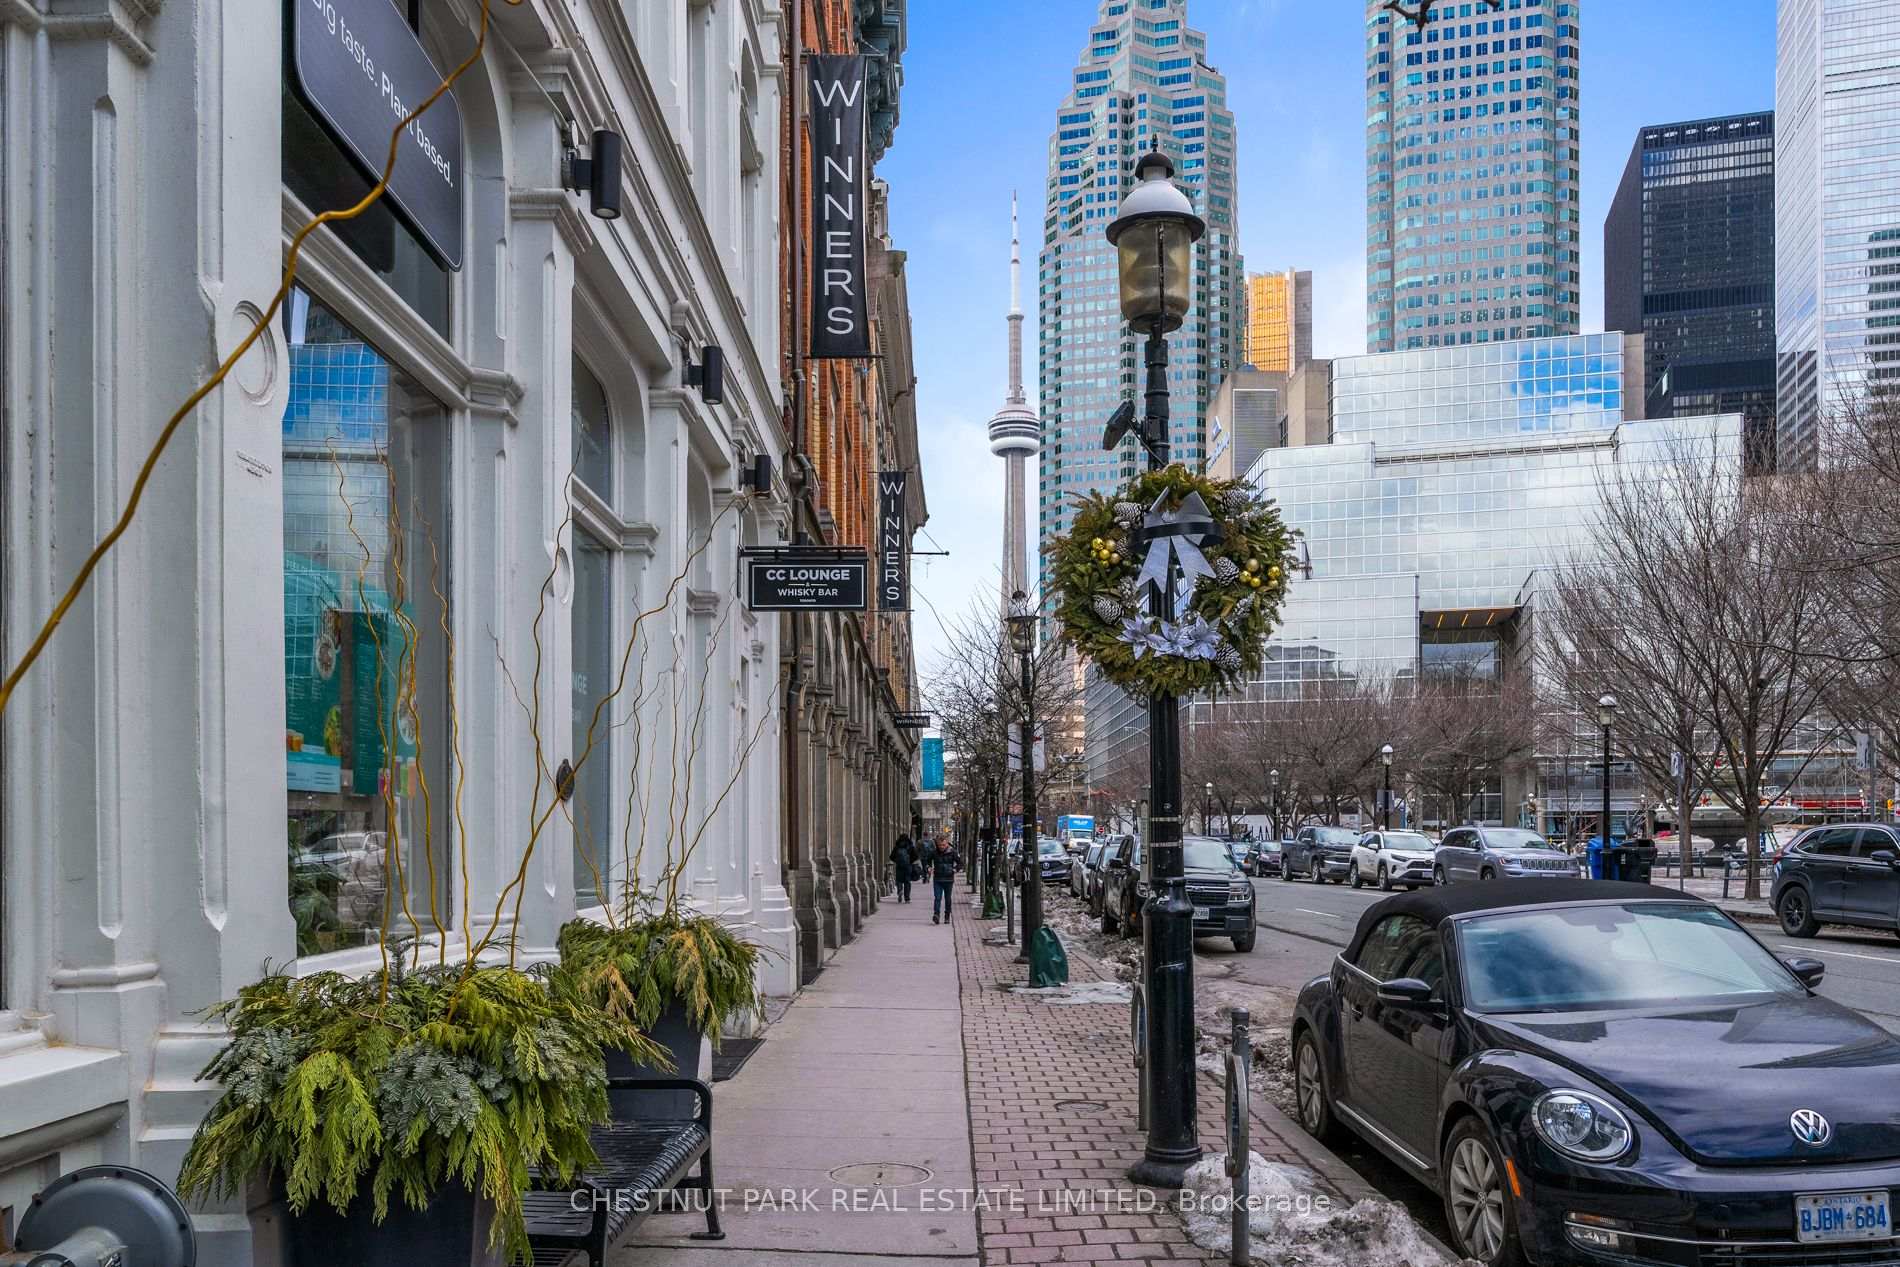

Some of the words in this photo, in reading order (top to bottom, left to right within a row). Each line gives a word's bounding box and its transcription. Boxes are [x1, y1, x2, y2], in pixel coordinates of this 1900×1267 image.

[312, 0, 336, 35] ig
[340, 16, 378, 88] taste.
[381, 71, 414, 136] Plant
[416, 119, 454, 188] based.
[813, 79, 861, 335] WINNERS
[766, 569, 786, 581] CC
[789, 569, 850, 581] LOUNGE
[881, 481, 904, 601] WINNERS
[778, 588, 816, 597] WHISKY
[818, 588, 838, 596] BAR
[1855, 1203, 1886, 1229] 684
